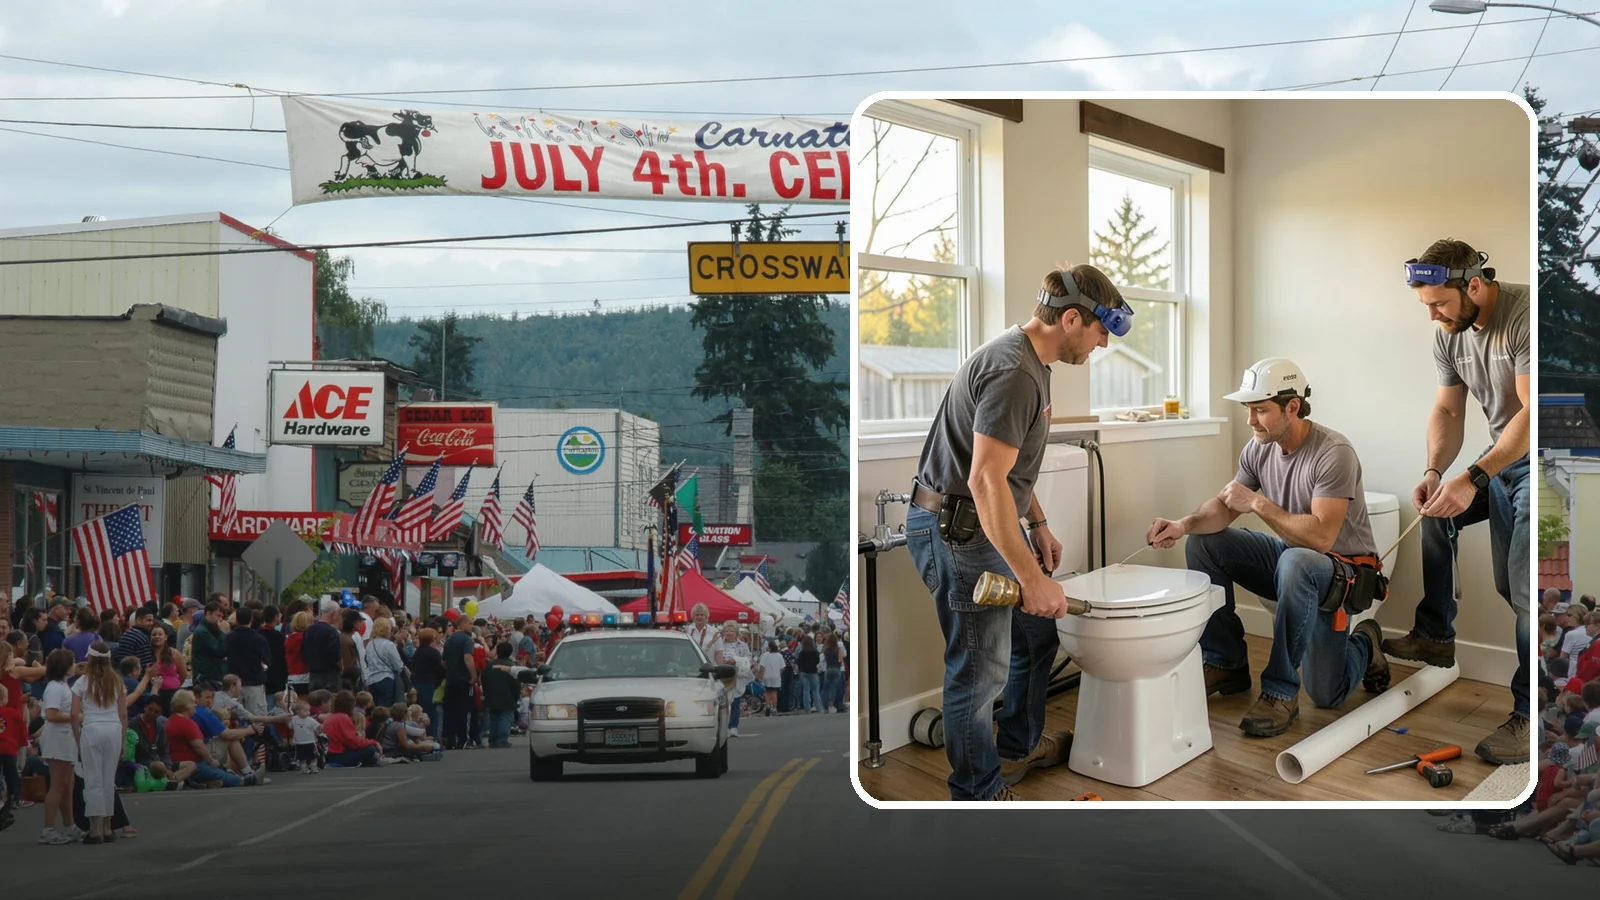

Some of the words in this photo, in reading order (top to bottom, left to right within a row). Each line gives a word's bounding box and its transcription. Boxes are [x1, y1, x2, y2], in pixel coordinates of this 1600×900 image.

[481, 141, 604, 191] JULY
[633, 150, 746, 197] 4th.
[697, 254, 850, 280] CROSSWA
[283, 380, 373, 420] ACE
[406, 409, 452, 422] CEDAR
[283, 421, 370, 437] Hardware
[83, 485, 93, 494] St.
[96, 485, 124, 495] Vincent
[126, 486, 134, 495] de
[138, 486, 155, 495] Paul
[213, 516, 330, 535] HARDARE
[688, 526, 741, 535] CRNATION
[699, 535, 730, 544] GLASS
